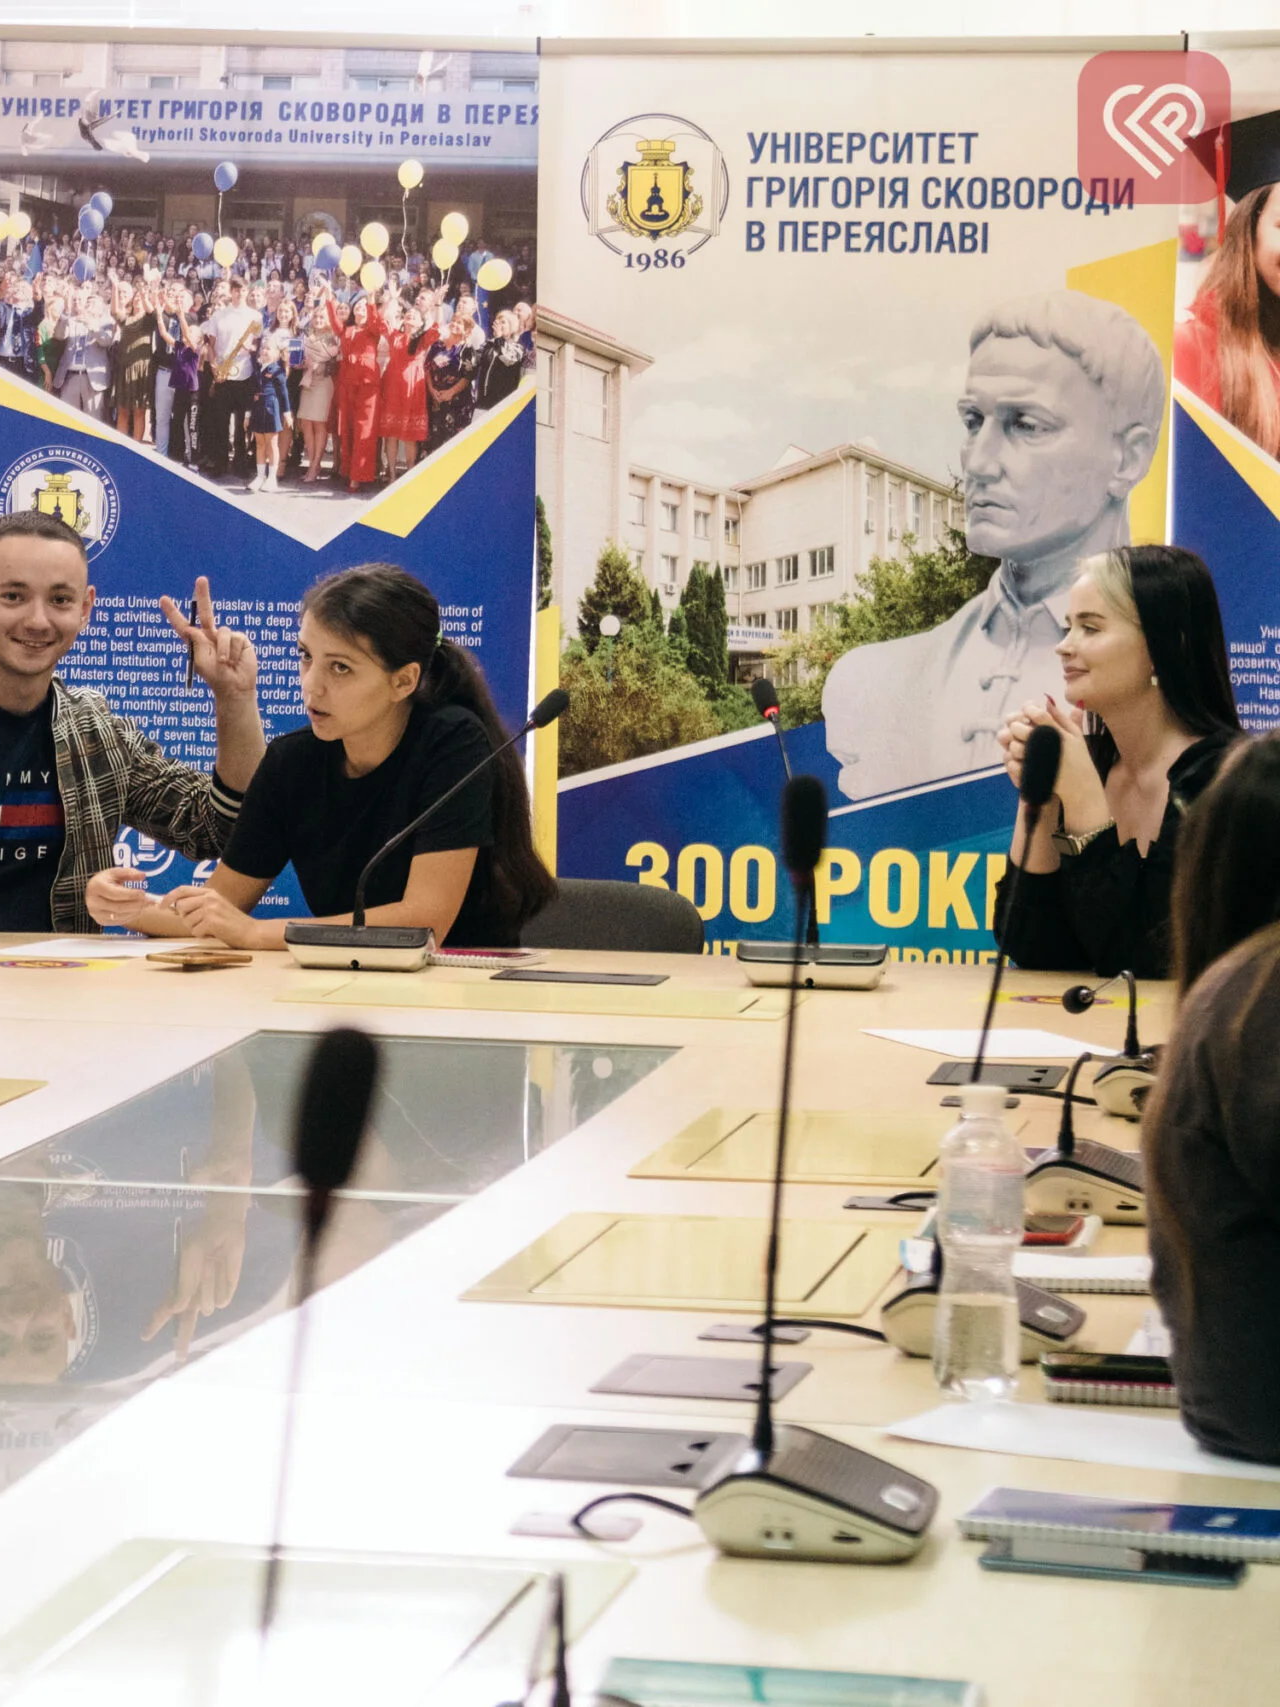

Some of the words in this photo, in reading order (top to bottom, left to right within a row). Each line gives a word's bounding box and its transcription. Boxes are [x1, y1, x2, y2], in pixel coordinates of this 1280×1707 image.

[1, 96, 152, 119] УНІВЕРИТЕТ
[158, 99, 263, 122] ГРИГОРІЯ
[278, 101, 424, 127] СКОВОРОДИ
[436, 103, 452, 124] В
[199, 127, 282, 143] Skovoroda
[289, 129, 373, 148] University
[379, 131, 394, 145] in
[400, 131, 492, 147] Pereiaslav
[746, 132, 979, 164] УНІВЕРСИТЕТ
[746, 176, 909, 209] ГРИГОРІЯ
[921, 176, 1135, 216] СКОВОРОДИ
[745, 220, 766, 253] В
[778, 220, 989, 254] ПЕРЕЯСЛАВІ
[624, 248, 686, 273] 1986
[0, 452, 44, 494] SKOVORODA
[48, 449, 102, 473] UNIVERSITY
[93, 596, 125, 608] oroda
[255, 600, 265, 611] is
[267, 601, 274, 612] a
[471, 605, 483, 618] of
[96, 610, 109, 622] its
[113, 610, 162, 623] activities
[225, 616, 239, 626] on
[244, 614, 261, 626] the
[266, 615, 293, 629] deep
[471, 620, 483, 632] of
[115, 627, 134, 638] our
[137, 626, 181, 639] Univers
[261, 629, 278, 641] the
[282, 630, 299, 642] las
[90, 639, 107, 651] the
[110, 640, 134, 652] best
[137, 641, 188, 655] examples
[1230, 641, 1266, 655] вищої
[112, 654, 166, 667] institution
[171, 655, 183, 668] of
[70, 668, 114, 681] Masters
[120, 669, 160, 683] degrees
[162, 671, 173, 682] in
[275, 673, 285, 685] in
[1229, 671, 1280, 686] суспільс
[129, 684, 139, 697] in
[261, 688, 291, 700] order
[122, 699, 167, 714] monthly
[169, 700, 214, 715] stipend)
[148, 729, 160, 740] of
[164, 731, 196, 741] seven
[170, 744, 181, 756] of
[185, 744, 217, 757] Histor
[625, 841, 776, 923] 300
[815, 847, 1008, 931] РОКІ
